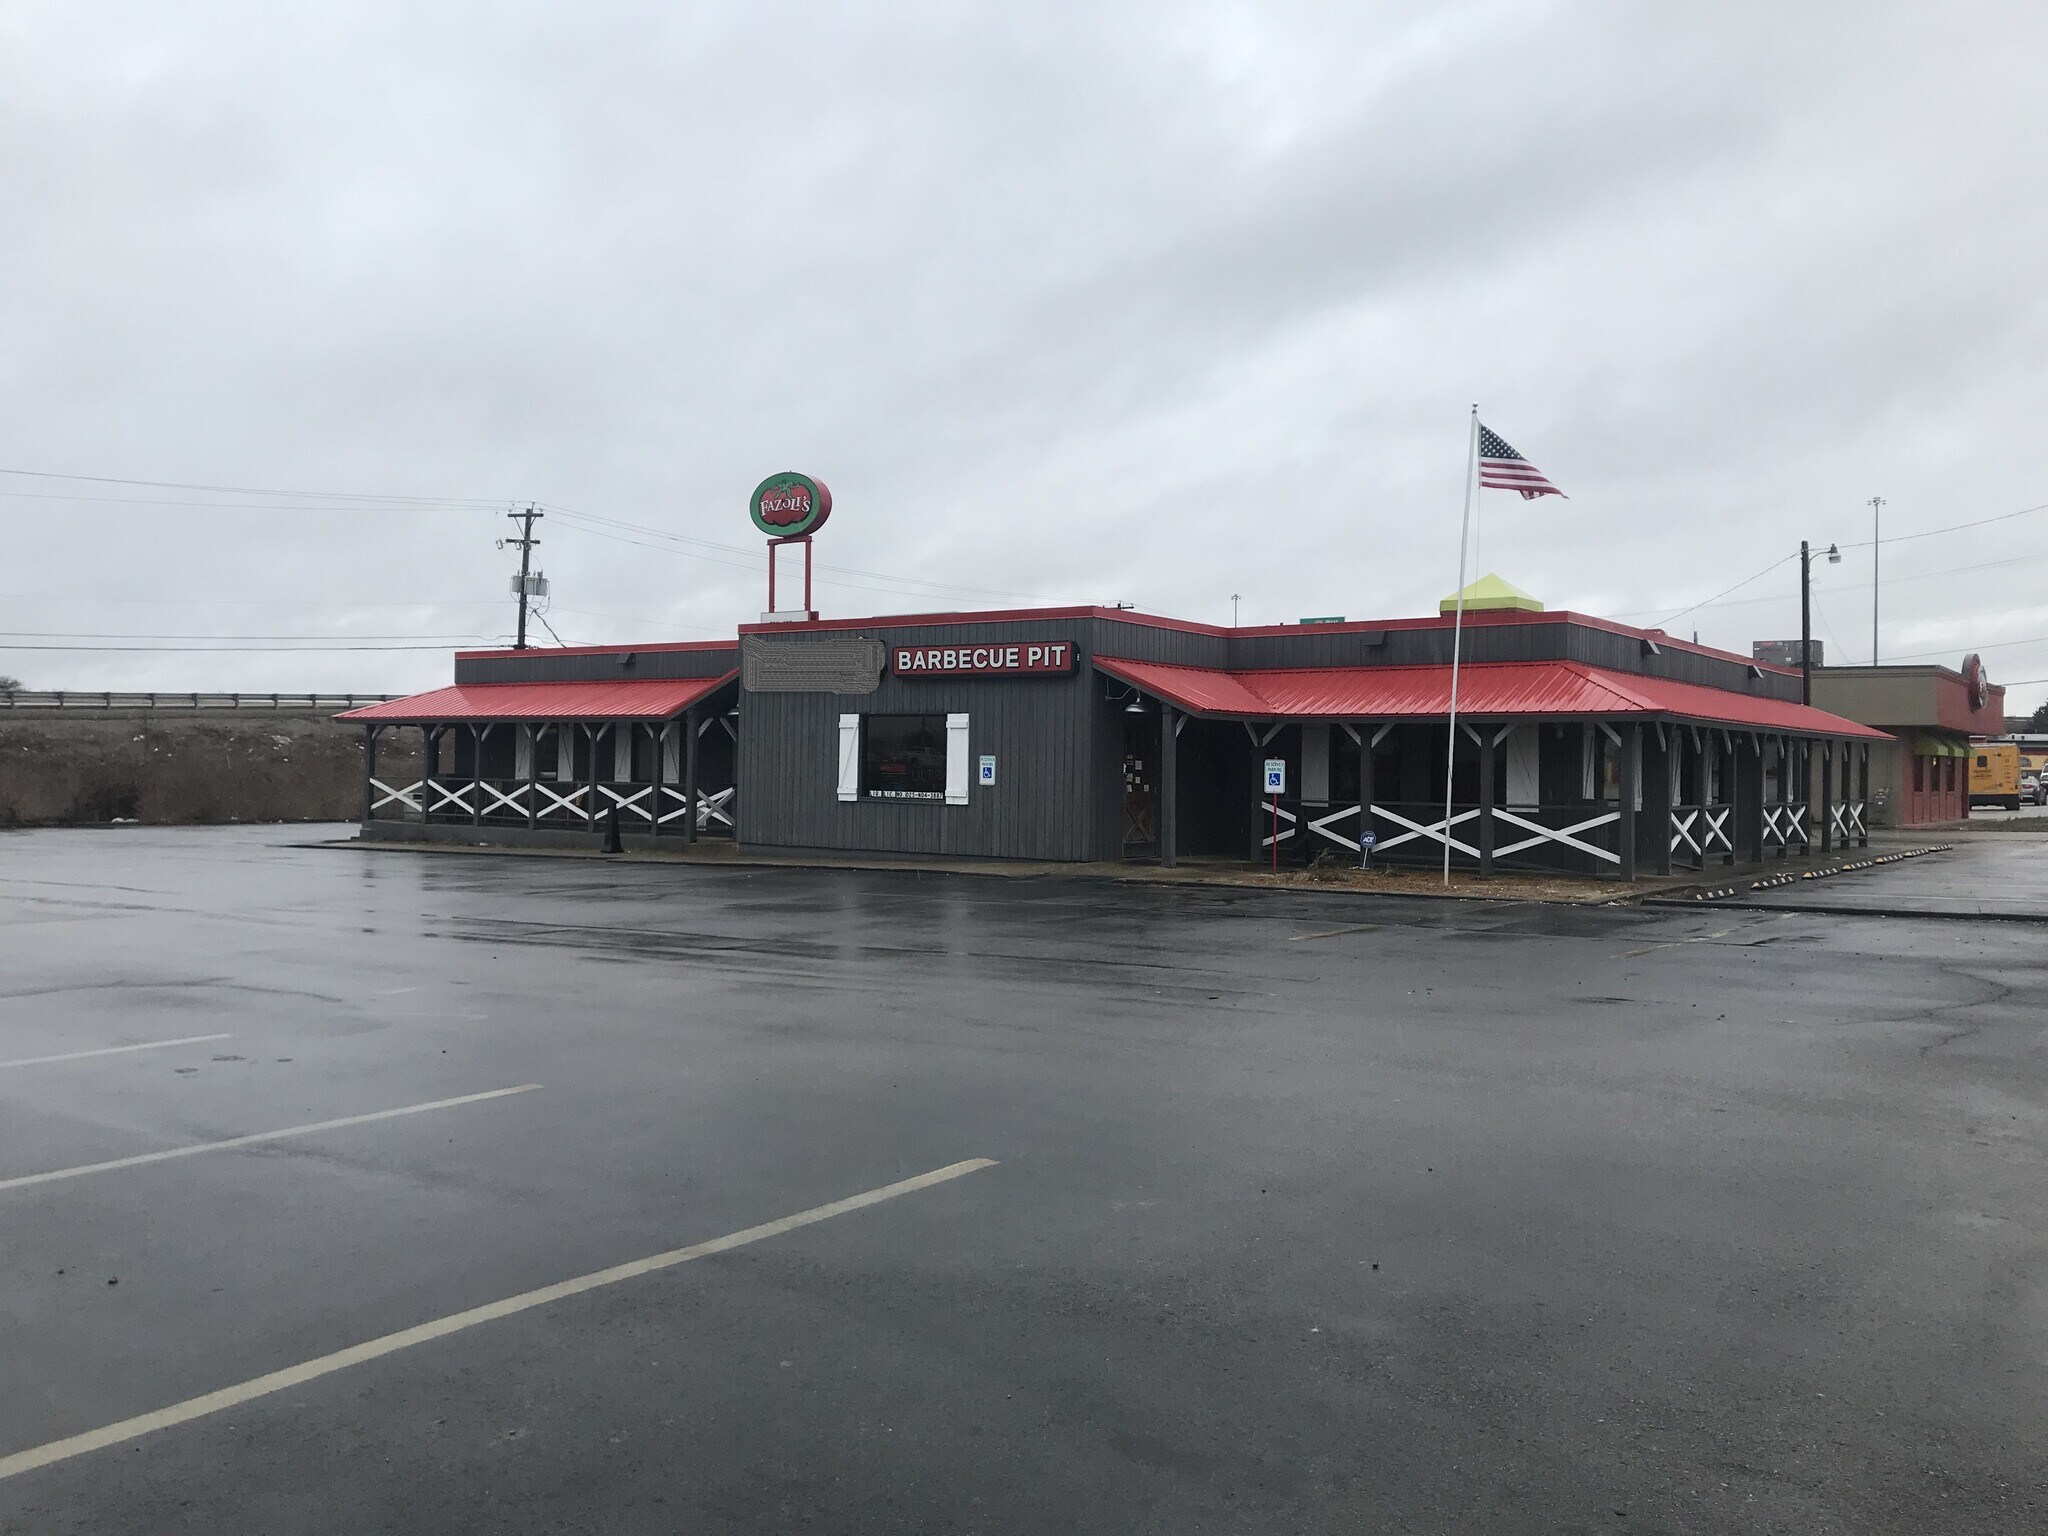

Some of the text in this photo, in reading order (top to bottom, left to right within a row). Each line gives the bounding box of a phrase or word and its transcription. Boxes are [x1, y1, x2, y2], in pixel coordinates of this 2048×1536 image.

[760, 496, 811, 517] FAZOLI'S
[898, 645, 1067, 670] BARBECUE PIT
